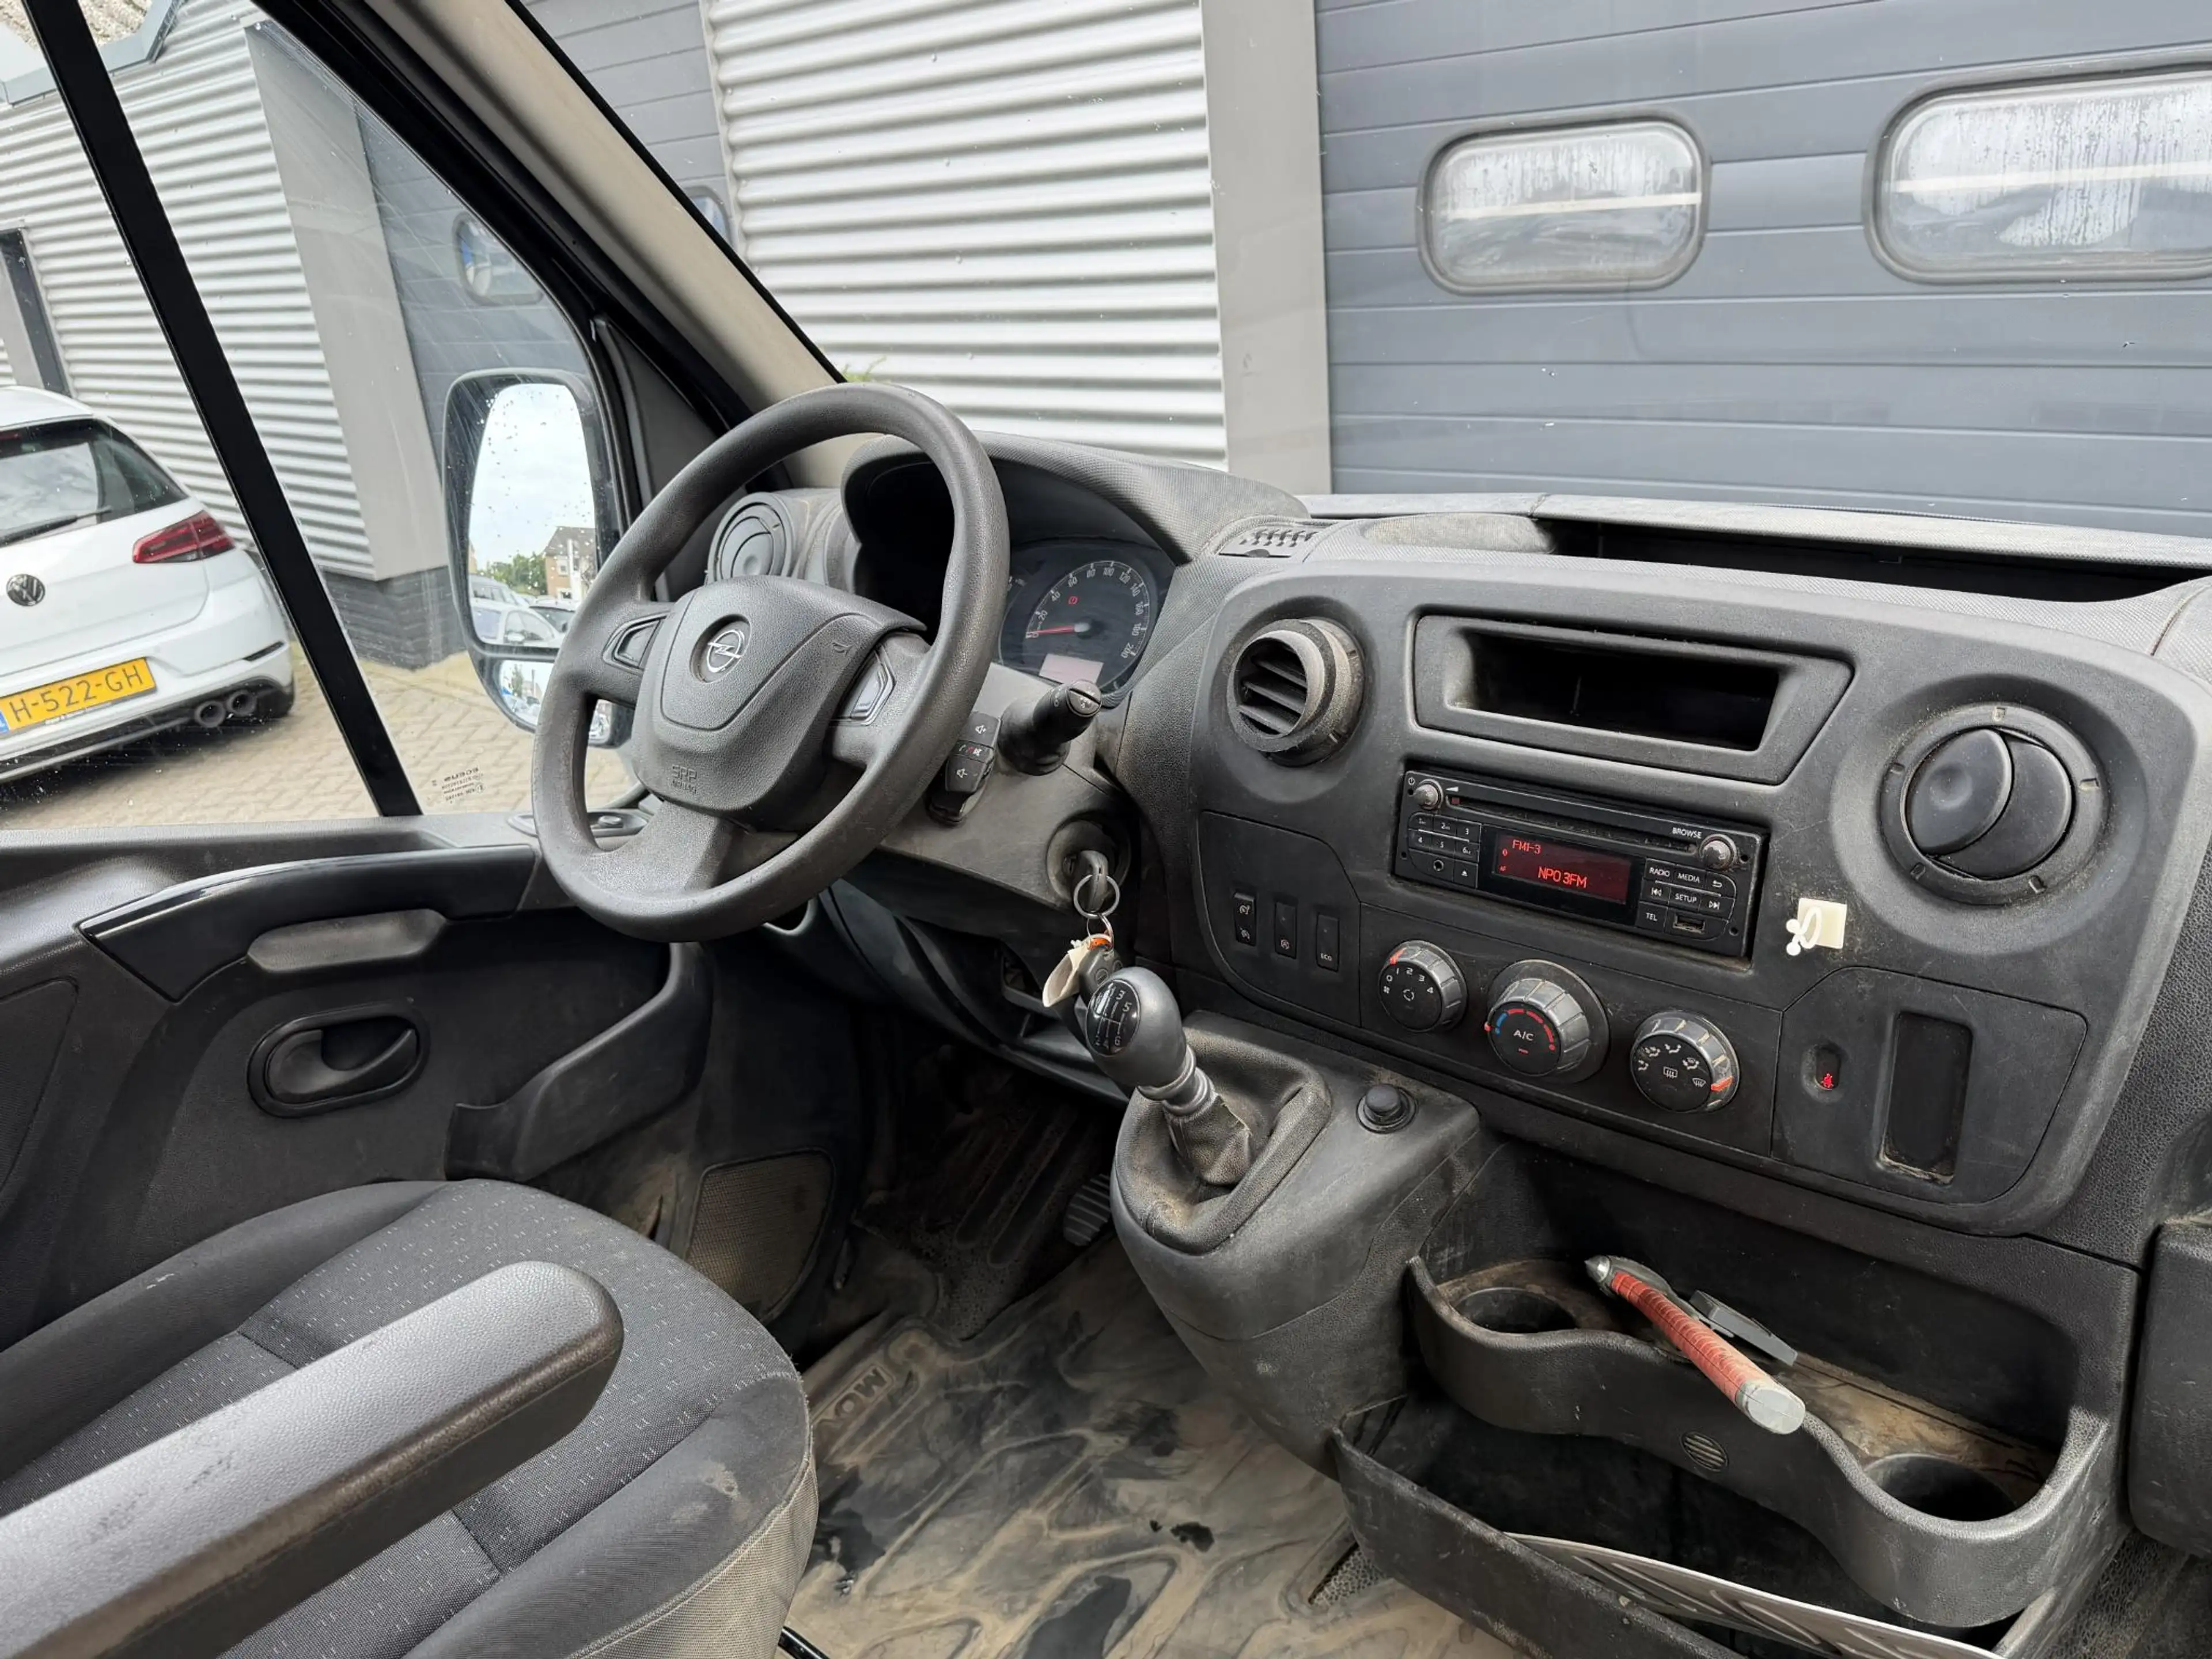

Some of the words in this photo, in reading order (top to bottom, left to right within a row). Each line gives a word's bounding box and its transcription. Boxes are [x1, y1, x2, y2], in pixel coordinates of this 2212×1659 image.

[1050, 591, 1061, 602] 40
[1037, 609, 1048, 620] 20
[9, 665, 143, 722] H-522-GH
[1672, 827, 1702, 839] BROWSE
[1512, 839, 1541, 854] FM1-3
[1537, 866, 1562, 882] NPO
[1562, 872, 1588, 888] 3FM
[1649, 866, 1671, 877] RADIO
[1677, 872, 1700, 884] MEDIA
[1675, 893, 1697, 903] SETUP
[1645, 912, 1658, 922] TEL
[1406, 967, 1414, 975] 2
[1116, 989, 1126, 1000] 3
[1122, 1001, 1132, 1012] 5
[1114, 1035, 1122, 1046] 6
[1513, 1029, 1534, 1041] A/C
